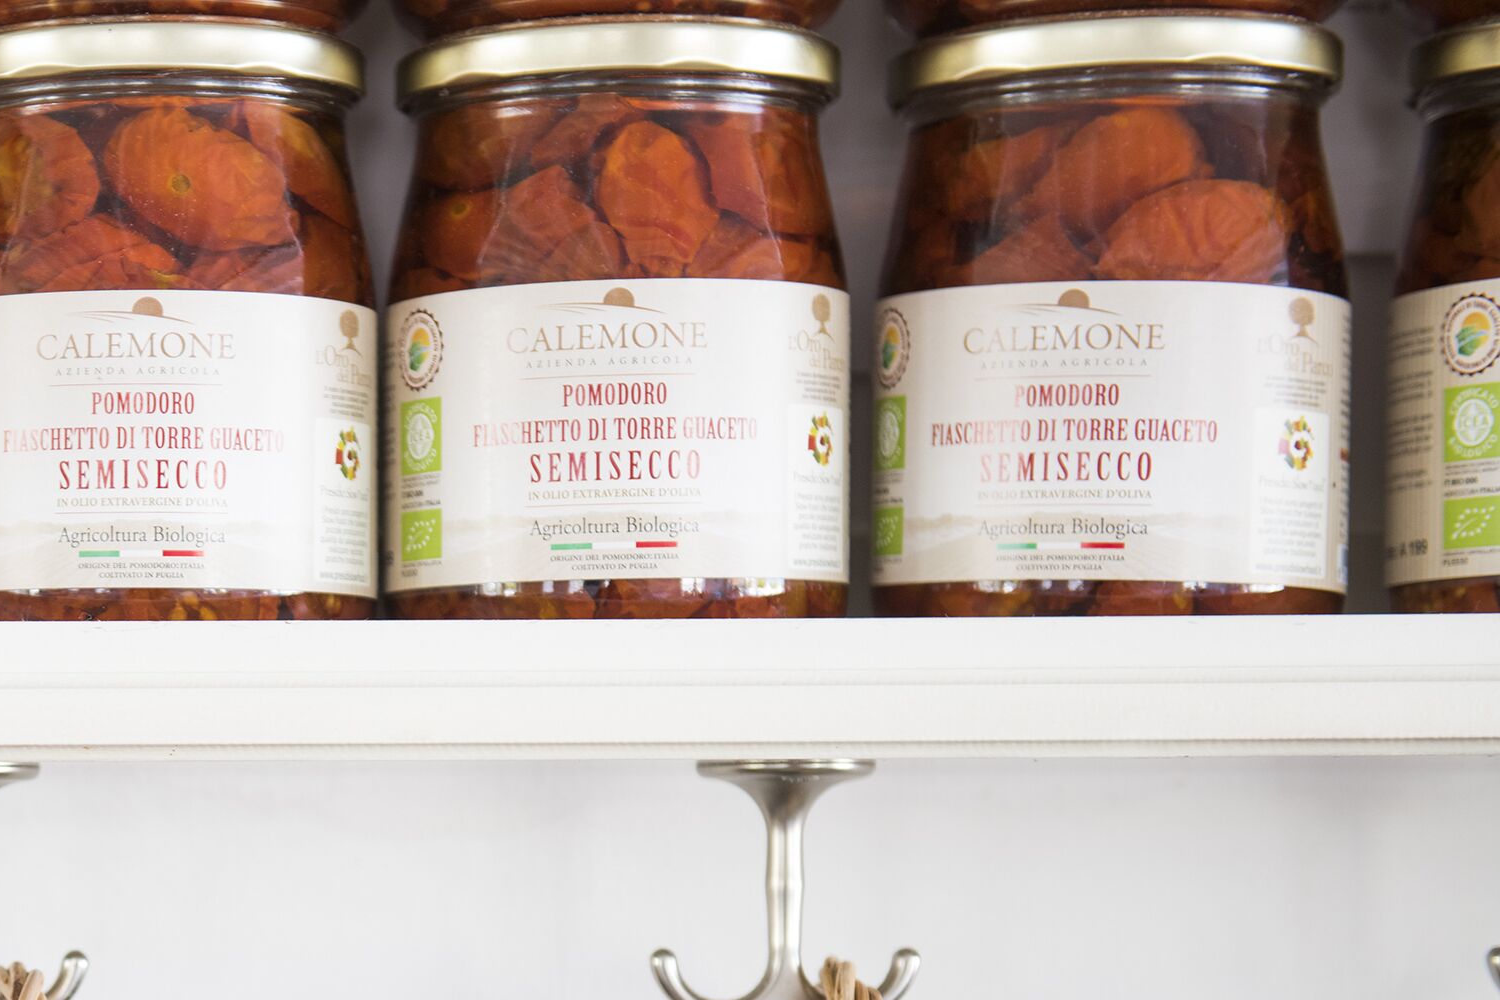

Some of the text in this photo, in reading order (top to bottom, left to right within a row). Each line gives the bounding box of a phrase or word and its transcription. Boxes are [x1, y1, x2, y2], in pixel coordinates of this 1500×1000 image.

[36, 331, 235, 361] CALEMONE
[506, 322, 707, 354] CALEMONE
[964, 324, 1165, 354] CALEMONE
[55, 366, 220, 376] AZIENDA AGRICOLA
[526, 356, 693, 368] AZIENDA AGRICOLA
[981, 358, 1147, 369] AZIENDA AGRICOLA
[91, 392, 195, 415] POMODORO
[563, 383, 668, 407] POMODORO
[1015, 384, 1119, 407] POMODORO
[3, 427, 284, 453] FIASCHETTO DI TORRE GUACETO
[474, 417, 757, 448] FIASCHETTO DI TORRE GUACETO
[932, 418, 1217, 447] FIASCHETTO DI TORRE GUACETO
[59, 459, 227, 490] SEMISECCO
[531, 450, 700, 483] SEMISECCO
[980, 452, 1152, 483] SEMISECCO
[58, 526, 226, 548] Agricoltura Biologica
[531, 516, 700, 540] Agricoltura Biologica
[978, 518, 1148, 540] Agricoltura Biologica
